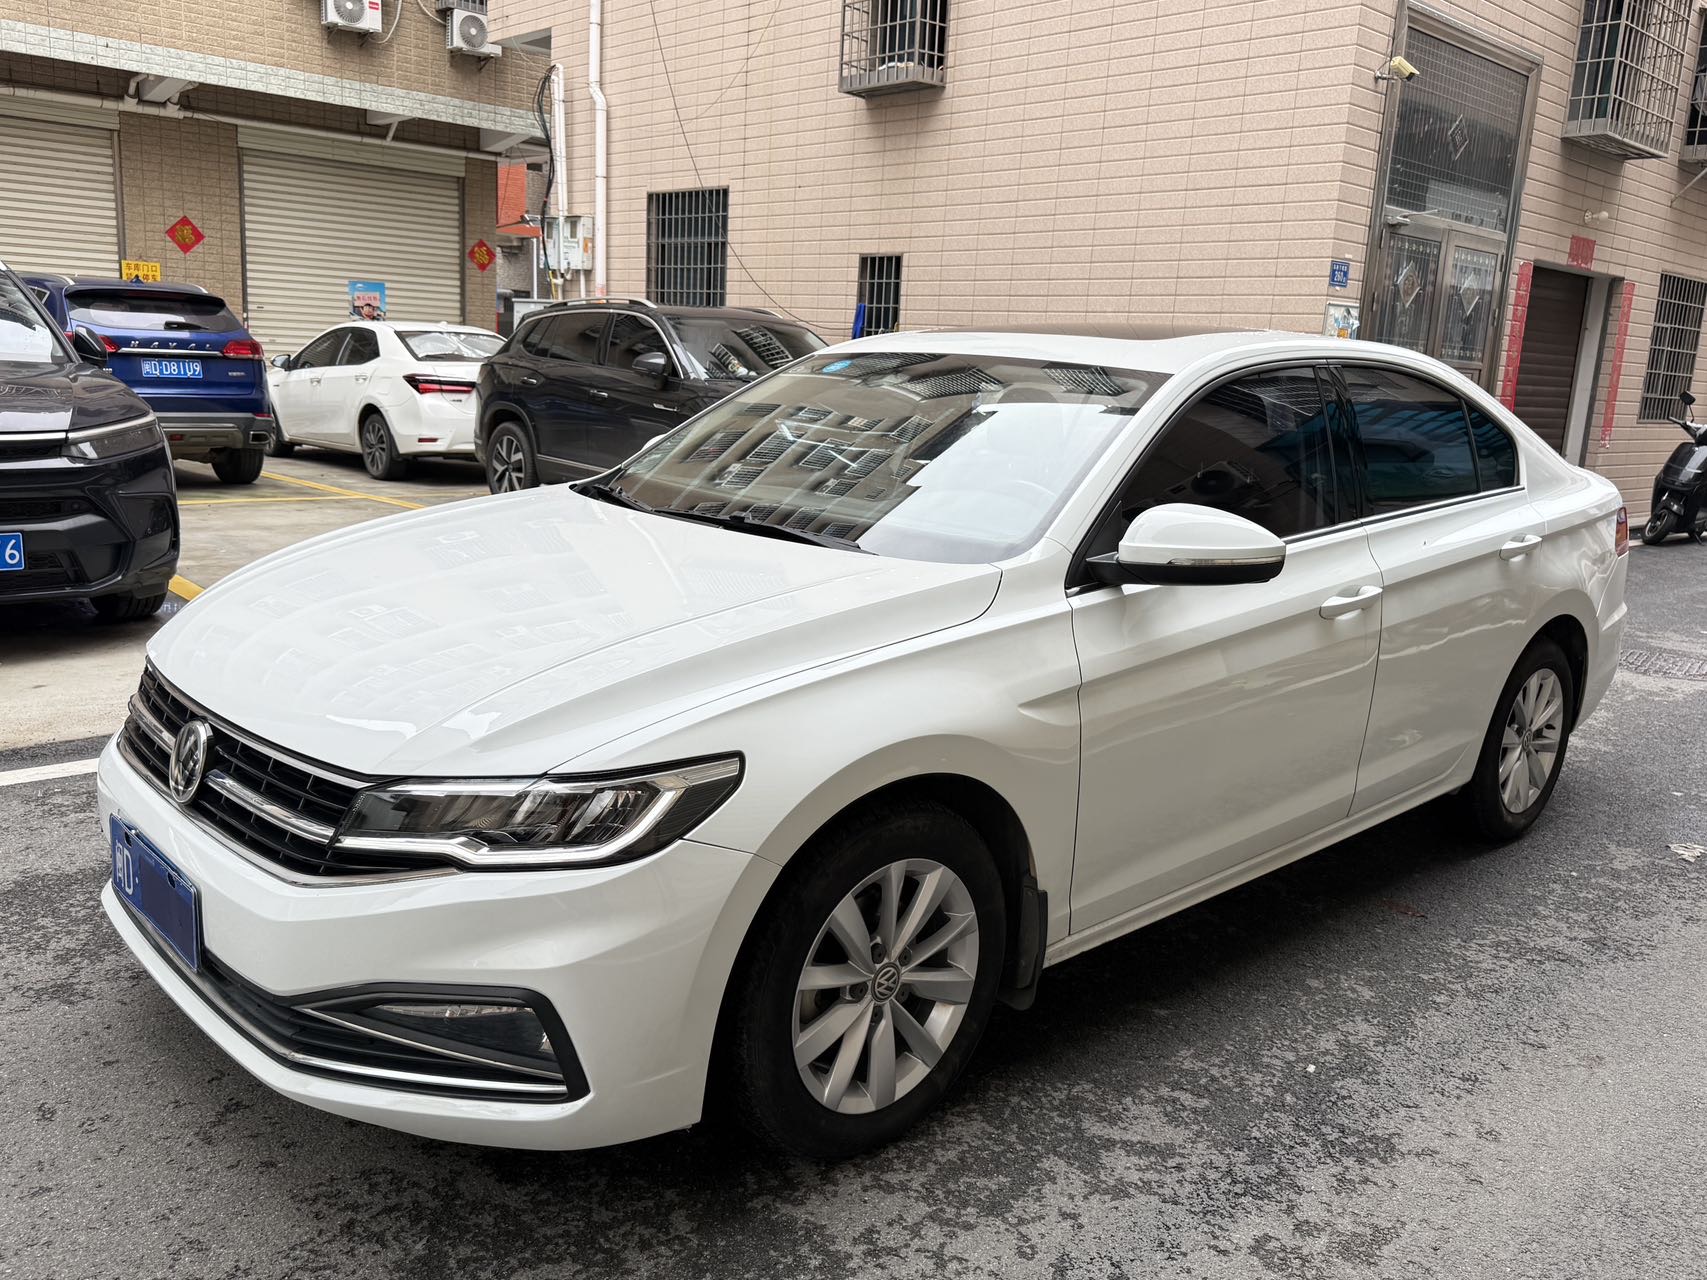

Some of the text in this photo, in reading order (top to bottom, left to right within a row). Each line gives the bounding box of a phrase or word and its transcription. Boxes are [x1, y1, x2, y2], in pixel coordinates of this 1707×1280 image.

[126, 262, 158, 273] 车库门口
[126, 272, 158, 282] 禁停车
[130, 340, 212, 349] HAVAL
[0, 539, 20, 565] 6
